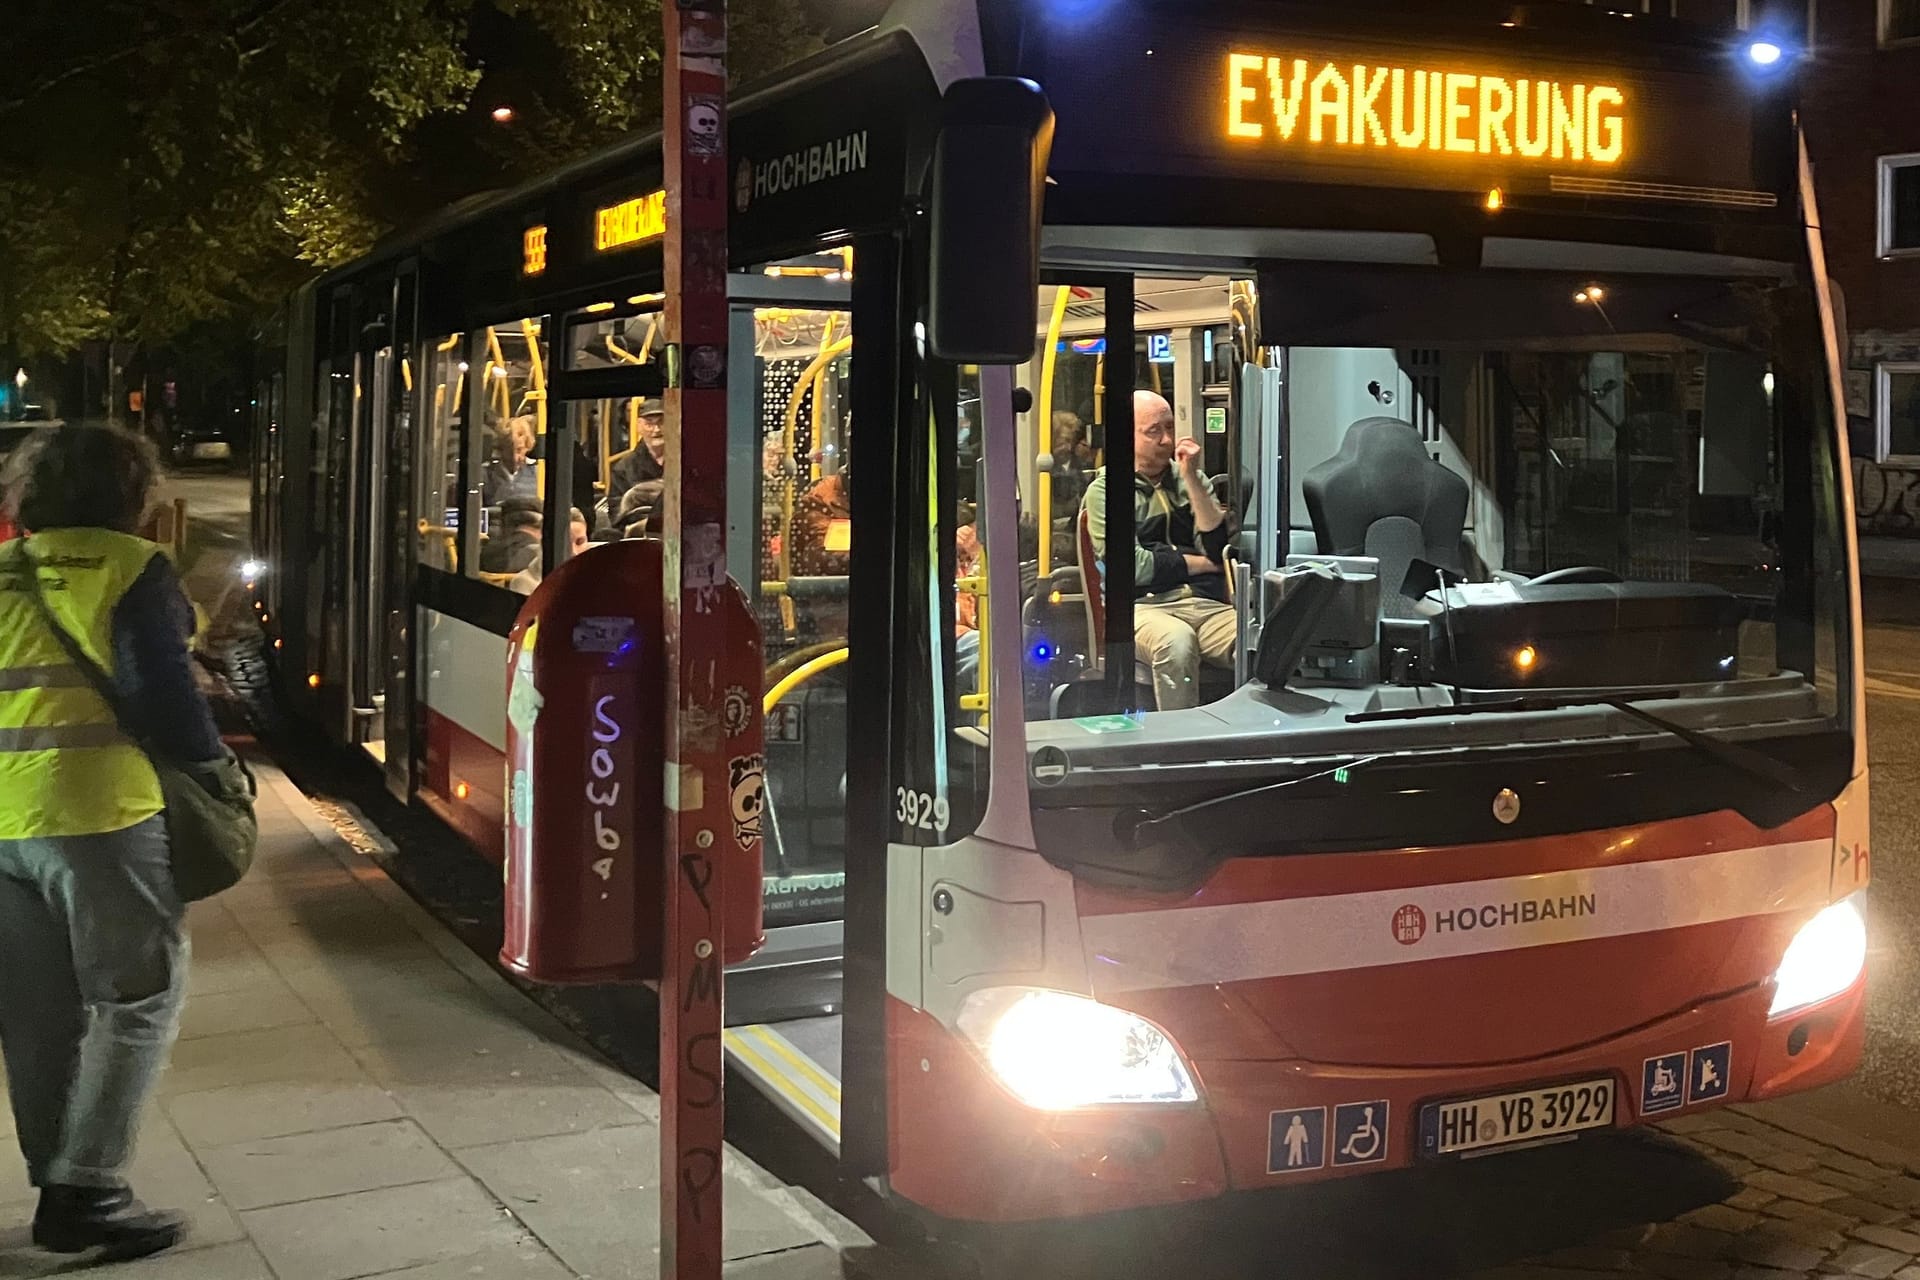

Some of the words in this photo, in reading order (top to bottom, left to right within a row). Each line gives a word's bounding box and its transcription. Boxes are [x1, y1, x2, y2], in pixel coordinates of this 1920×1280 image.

[1228, 52, 1624, 163] EVAKUIERUNG
[754, 130, 868, 199] HOCHBAHN
[896, 785, 950, 832] 3929
[1435, 893, 1596, 934] HOCHBAHN
[1441, 1105, 1478, 1148] HH
[1500, 1096, 1535, 1137] YB
[1541, 1085, 1609, 1130] 3929
